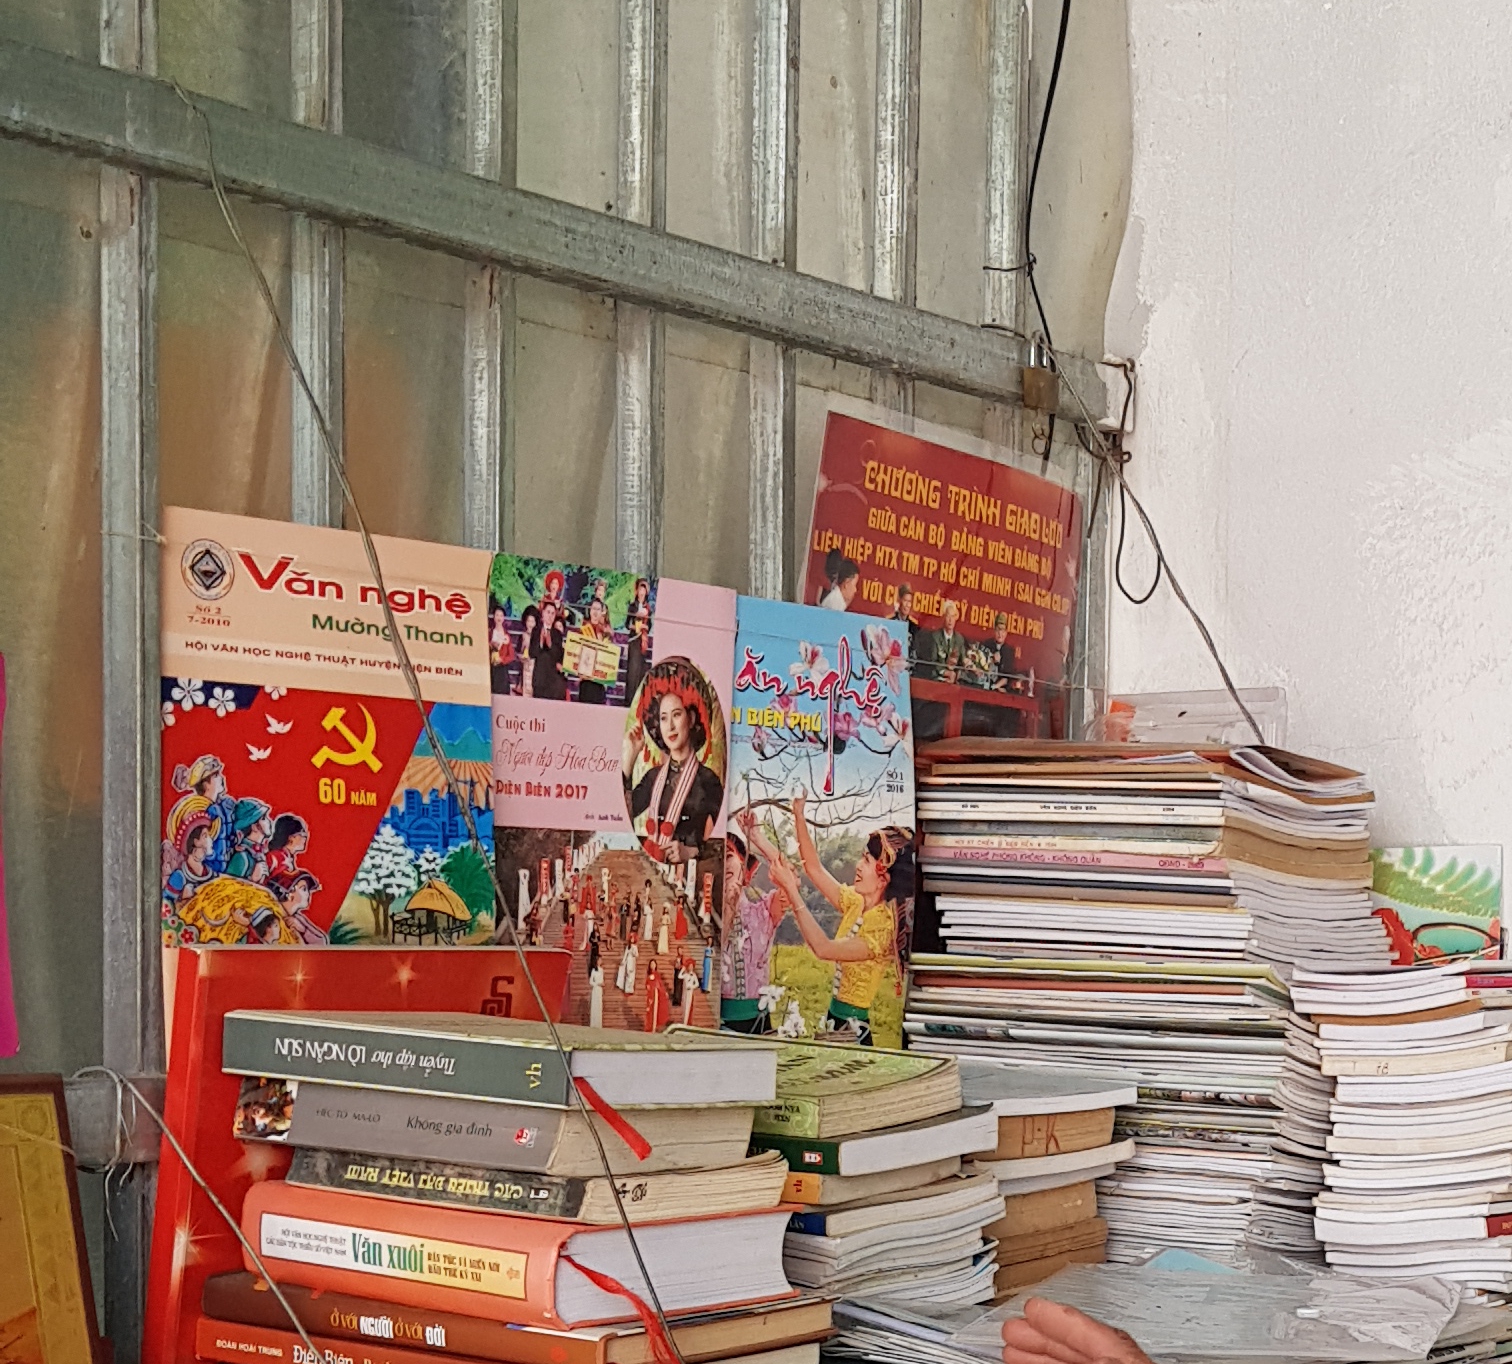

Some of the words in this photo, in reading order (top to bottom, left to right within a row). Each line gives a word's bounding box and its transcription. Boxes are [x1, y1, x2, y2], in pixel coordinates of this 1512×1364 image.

[864, 460, 941, 509] CHƯƠNG
[948, 484, 1001, 527] TRÌNH
[1005, 504, 1040, 540] GIAO
[867, 506, 897, 534] GIỮA
[899, 515, 925, 542] CÁN
[928, 523, 946, 550] BỘ
[951, 527, 984, 557] ĐẢNG
[988, 540, 1013, 565] VIÊN
[813, 528, 842, 553] LIÊN
[844, 536, 873, 564] HIỆP
[875, 545, 899, 570] HTX
[902, 551, 920, 575] TM
[922, 556, 938, 578] TP
[960, 566, 981, 589] CHÍ
[982, 572, 1012, 598] MINH
[238, 552, 343, 600] Văn
[360, 584, 472, 619] nghệ
[862, 578, 883, 604] VỚI
[912, 589, 946, 617] CHIẾ
[312, 614, 393, 641] Mường
[404, 624, 473, 646] Thanh
[1006, 611, 1025, 635] IÊN
[185, 641, 207, 651] HỘI
[212, 643, 238, 653] VĂN
[243, 648, 271, 657] HỌC
[275, 650, 311, 661] NGHỆ
[315, 653, 356, 667] THUẬT
[360, 659, 400, 671] HUYỆN
[411, 664, 432, 674] IỆN
[735, 646, 784, 695] ăn
[496, 714, 526, 734] Cuộc
[529, 718, 545, 732] thi
[747, 706, 785, 729] BIÊN
[555, 743, 588, 770] Hoa
[588, 746, 620, 772] Ban
[886, 784, 905, 794] 2016
[900, 771, 904, 781] 1
[319, 778, 346, 804] 60
[351, 789, 377, 806] NĂM
[525, 781, 551, 797] BIÊN
[555, 784, 588, 800] 2017
[305, 1040, 345, 1063] NGÂN
[347, 1045, 366, 1067] LÒ
[371, 1050, 393, 1069] thơ
[396, 1049, 416, 1071] tập
[419, 1051, 456, 1077] Tuyển
[526, 1062, 543, 1089] vh
[444, 1123, 462, 1136] gia
[381, 1168, 415, 1188] VIỆT
[351, 1233, 383, 1267] Văn
[387, 1243, 425, 1274] xuôi
[341, 1312, 358, 1331] với
[359, 1315, 394, 1339] NGƯỜI
[405, 1321, 423, 1340] với
[425, 1323, 446, 1347] ĐỜI
[258, 1345, 283, 1357] TRUNG
